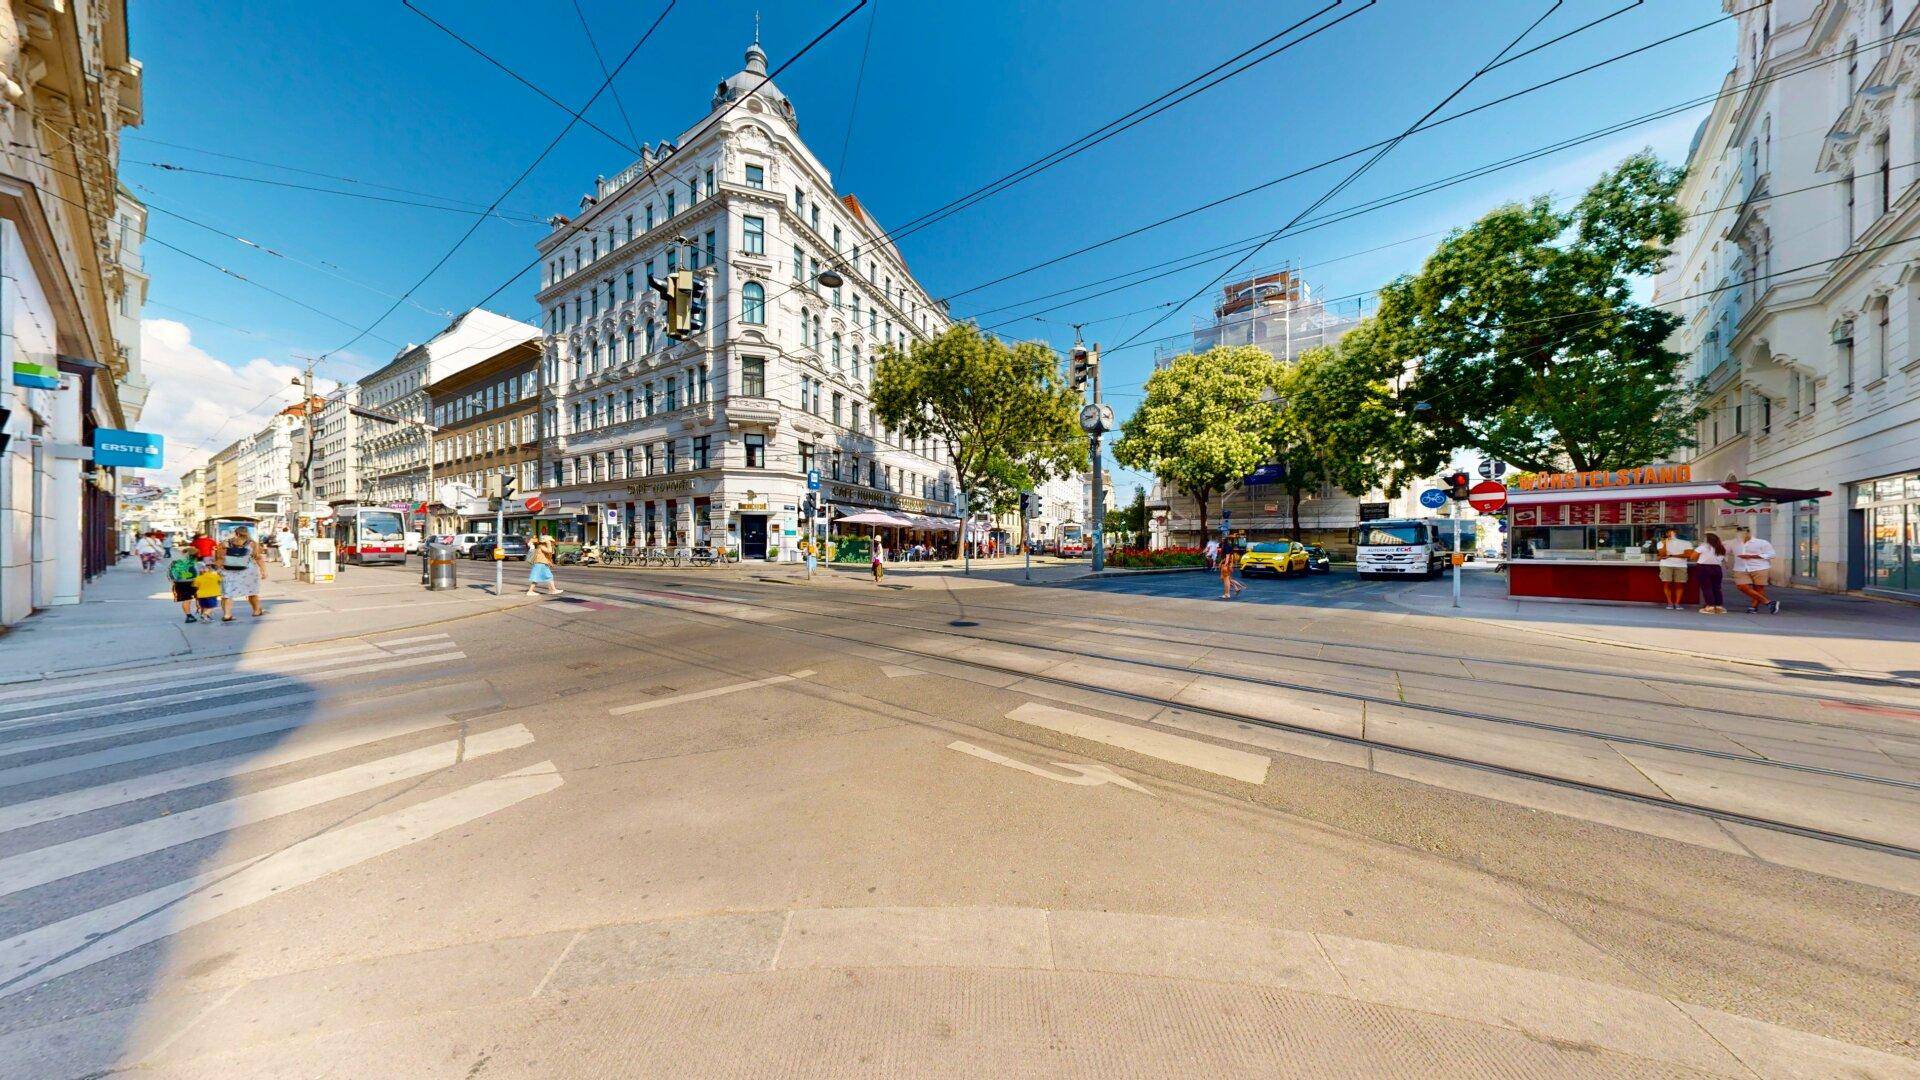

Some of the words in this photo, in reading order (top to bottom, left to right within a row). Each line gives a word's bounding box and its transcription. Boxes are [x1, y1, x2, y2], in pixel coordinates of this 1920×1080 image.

[101, 443, 143, 454] ERSTE
[1518, 464, 1691, 491] WÜRSTELSTAND
[858, 489, 886, 504] HUMMEL
[1720, 506, 1772, 515] SPAR
